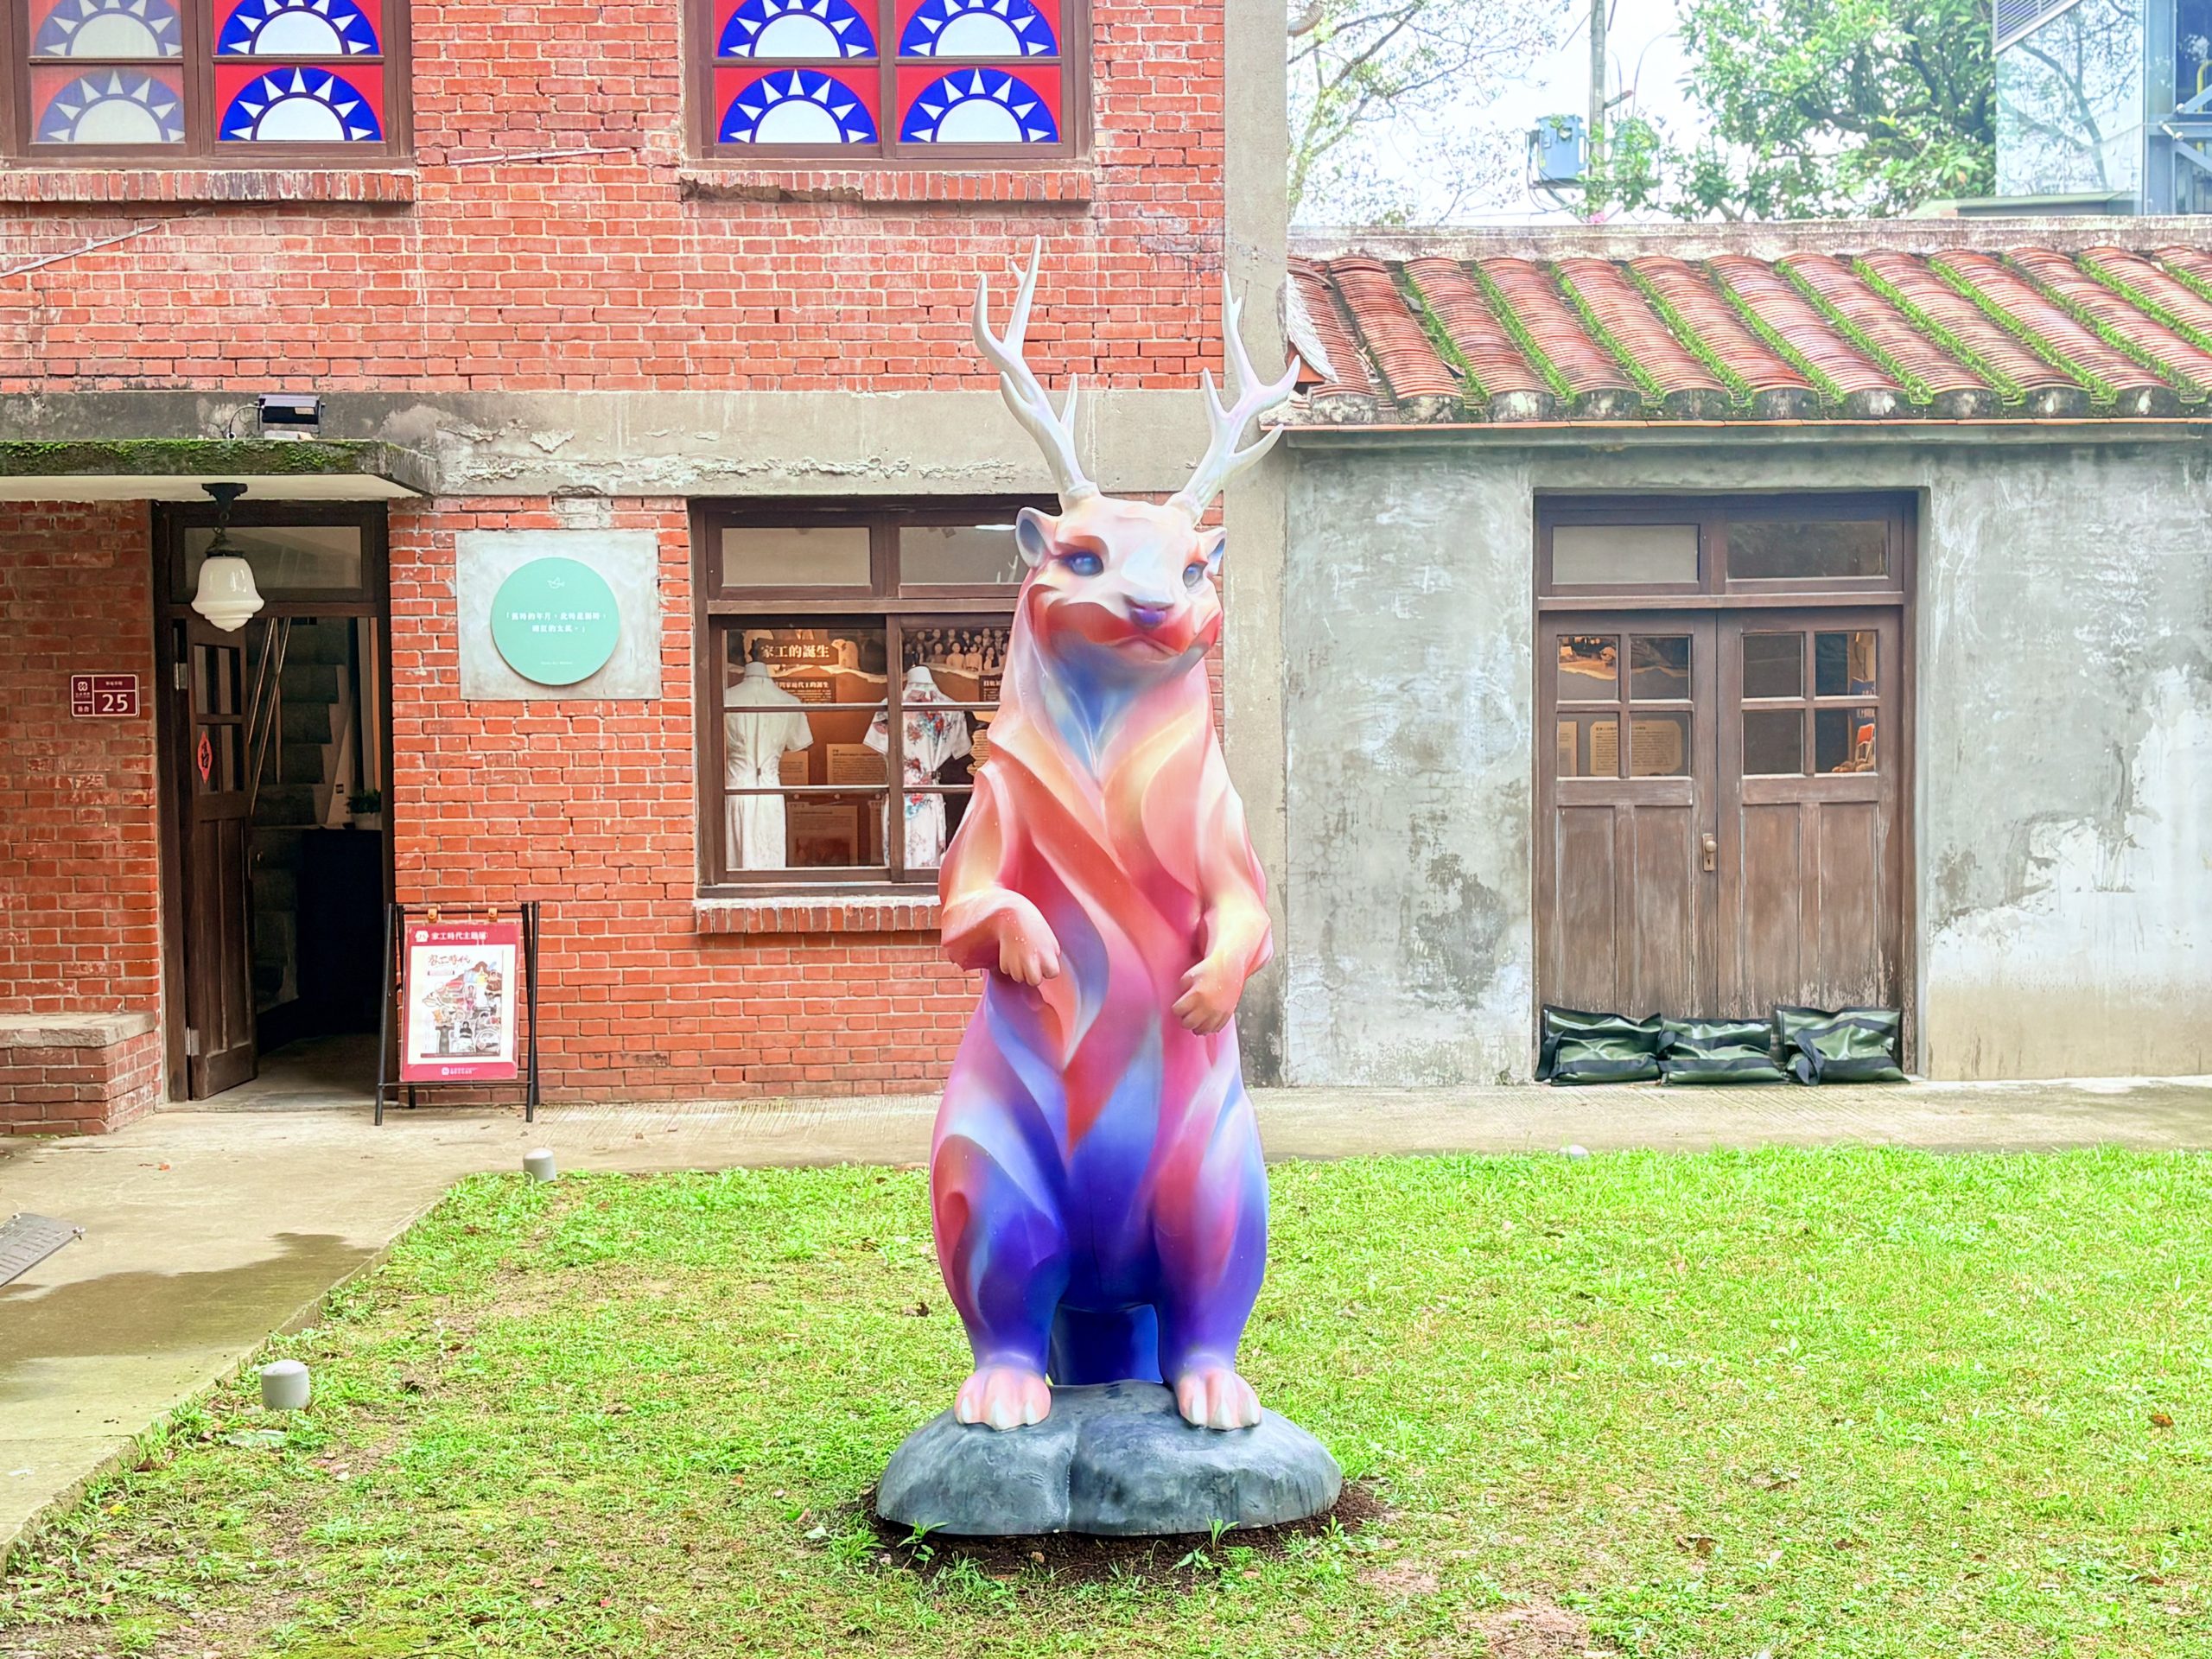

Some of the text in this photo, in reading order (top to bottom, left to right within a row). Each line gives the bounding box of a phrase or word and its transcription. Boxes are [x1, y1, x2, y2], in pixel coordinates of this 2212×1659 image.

[760, 645, 830, 658] 家工的誕生
[102, 693, 129, 712] 25
